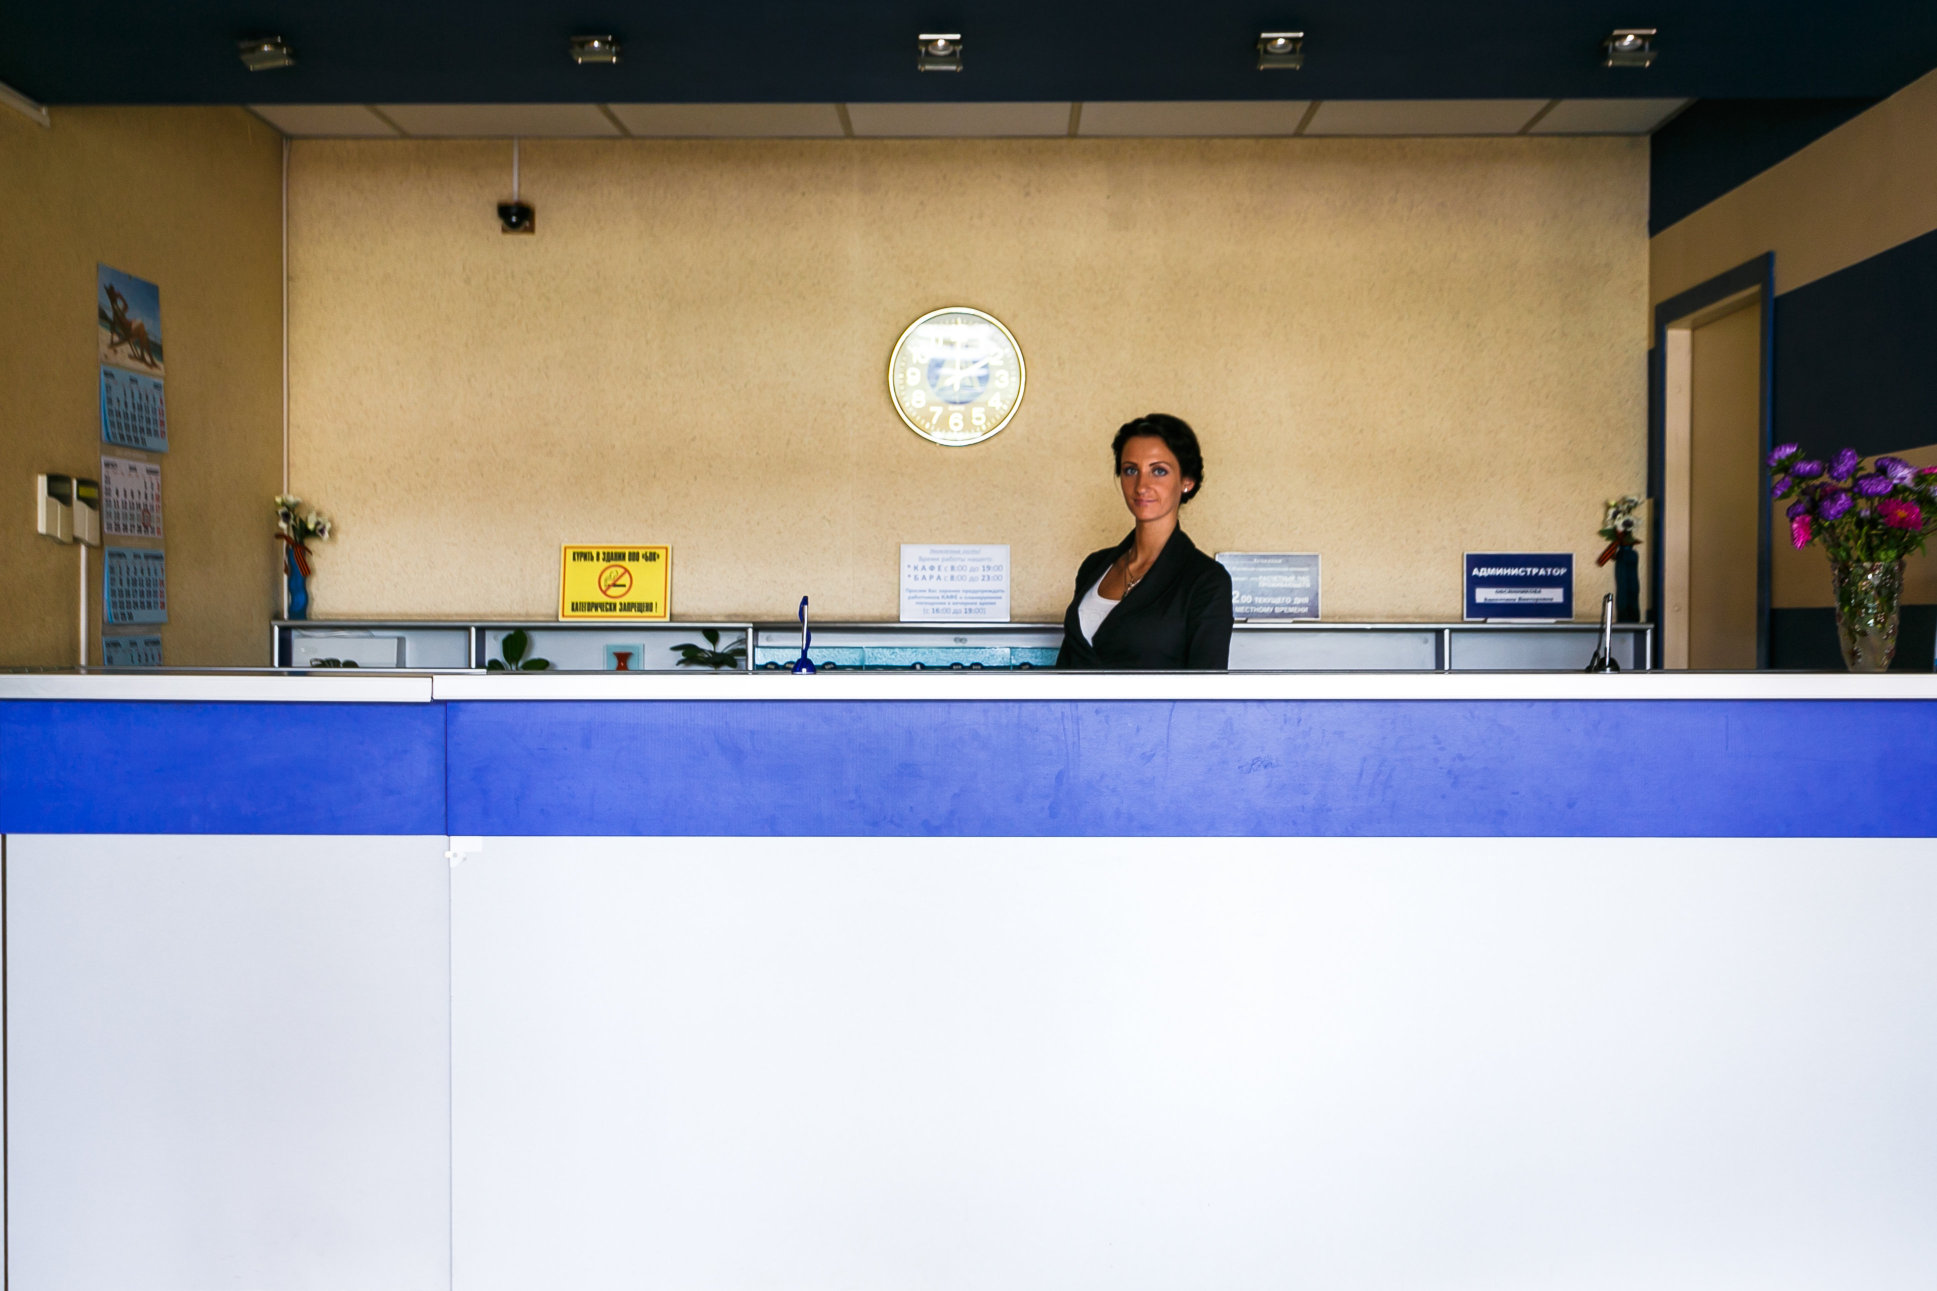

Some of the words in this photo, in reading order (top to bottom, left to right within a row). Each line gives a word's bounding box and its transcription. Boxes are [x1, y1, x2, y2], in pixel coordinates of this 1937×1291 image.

[906, 367, 921, 386] 9
[994, 369, 1010, 388] 3
[911, 389, 926, 408] 8
[988, 391, 1003, 410] 4
[929, 406, 943, 425] 7
[949, 412, 964, 431] 6
[970, 407, 986, 425] 5
[572, 551, 594, 562] КУРИТЬ
[602, 551, 626, 563] ЗДАНИИ
[982, 564, 1003, 572] 19:00
[1471, 567, 1568, 577] АДМИНИСТРАТОР
[571, 601, 617, 613] КАТЕГОРИЧЕСКИ
[619, 601, 653, 613] ЗАПРЕЩЕНО
[1254, 596, 1292, 604] ТЕКУЩЕГО
